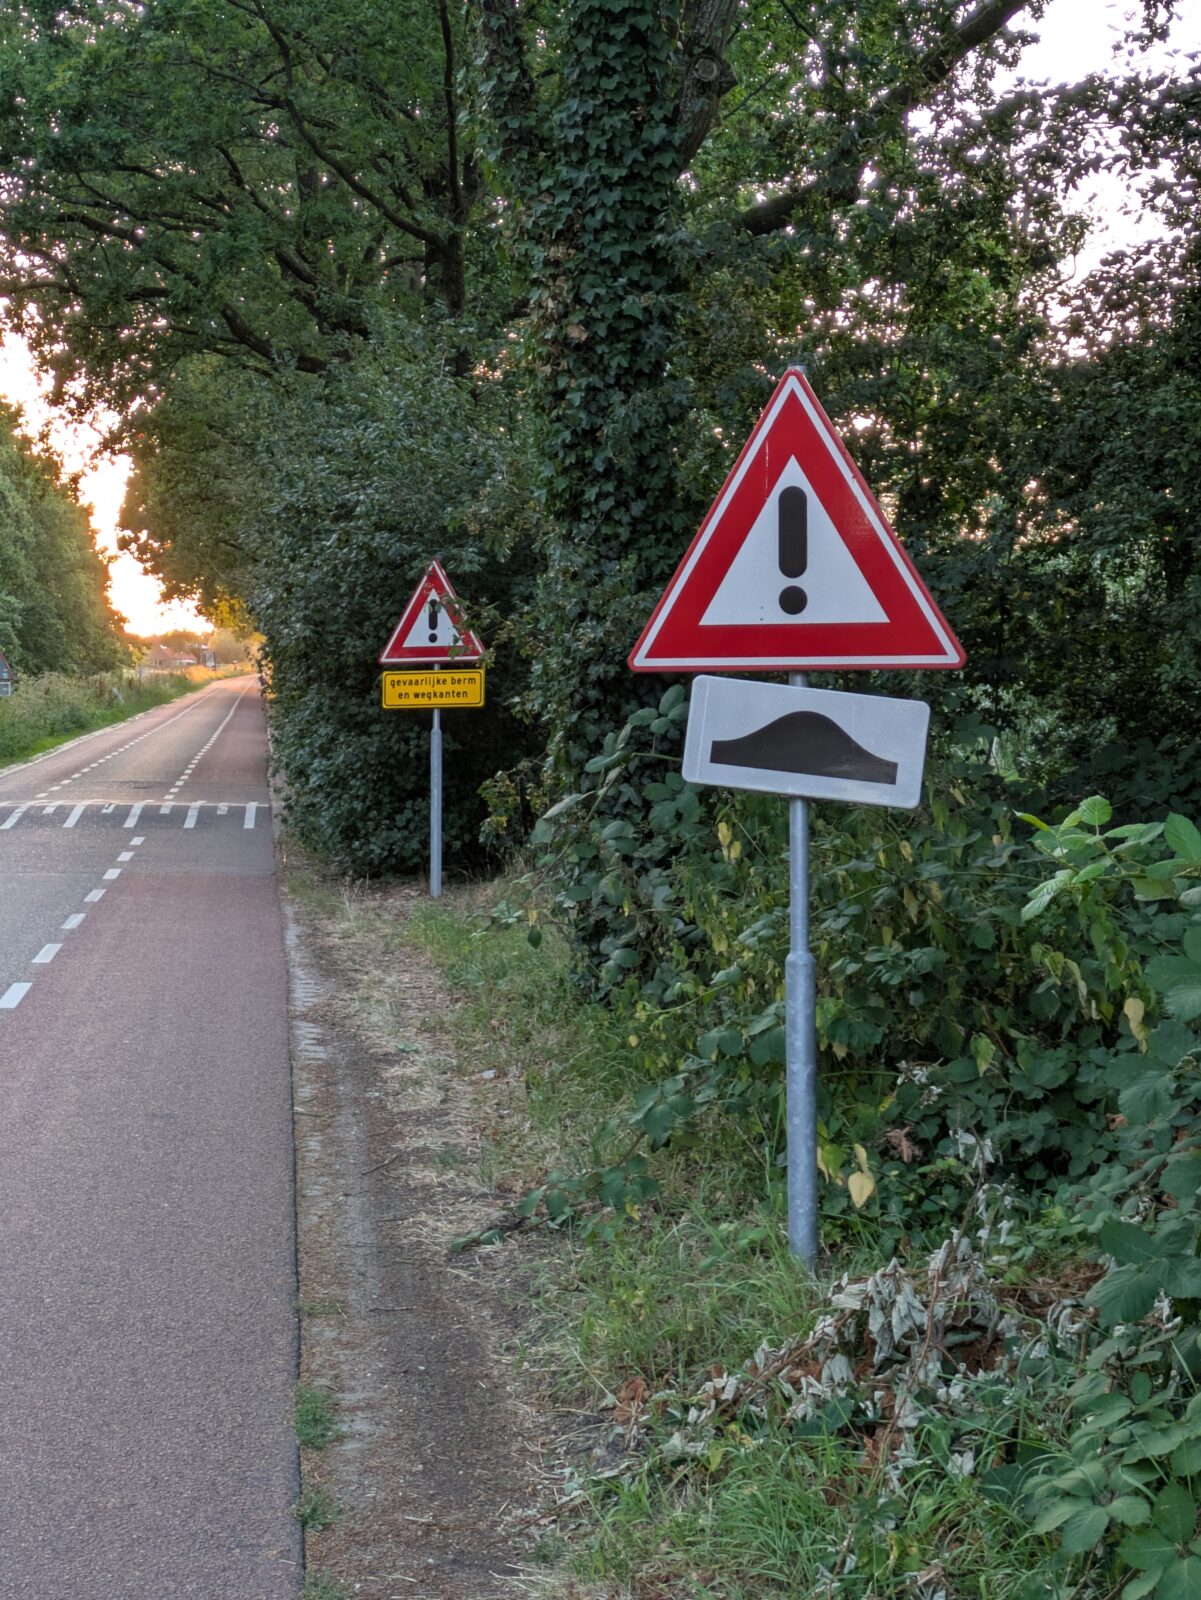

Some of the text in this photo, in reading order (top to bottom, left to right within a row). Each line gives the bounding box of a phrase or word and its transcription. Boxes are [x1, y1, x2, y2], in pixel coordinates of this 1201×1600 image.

[390, 676, 476, 688] gevaarlijke berm
[398, 690, 468, 701] en wegkanten
